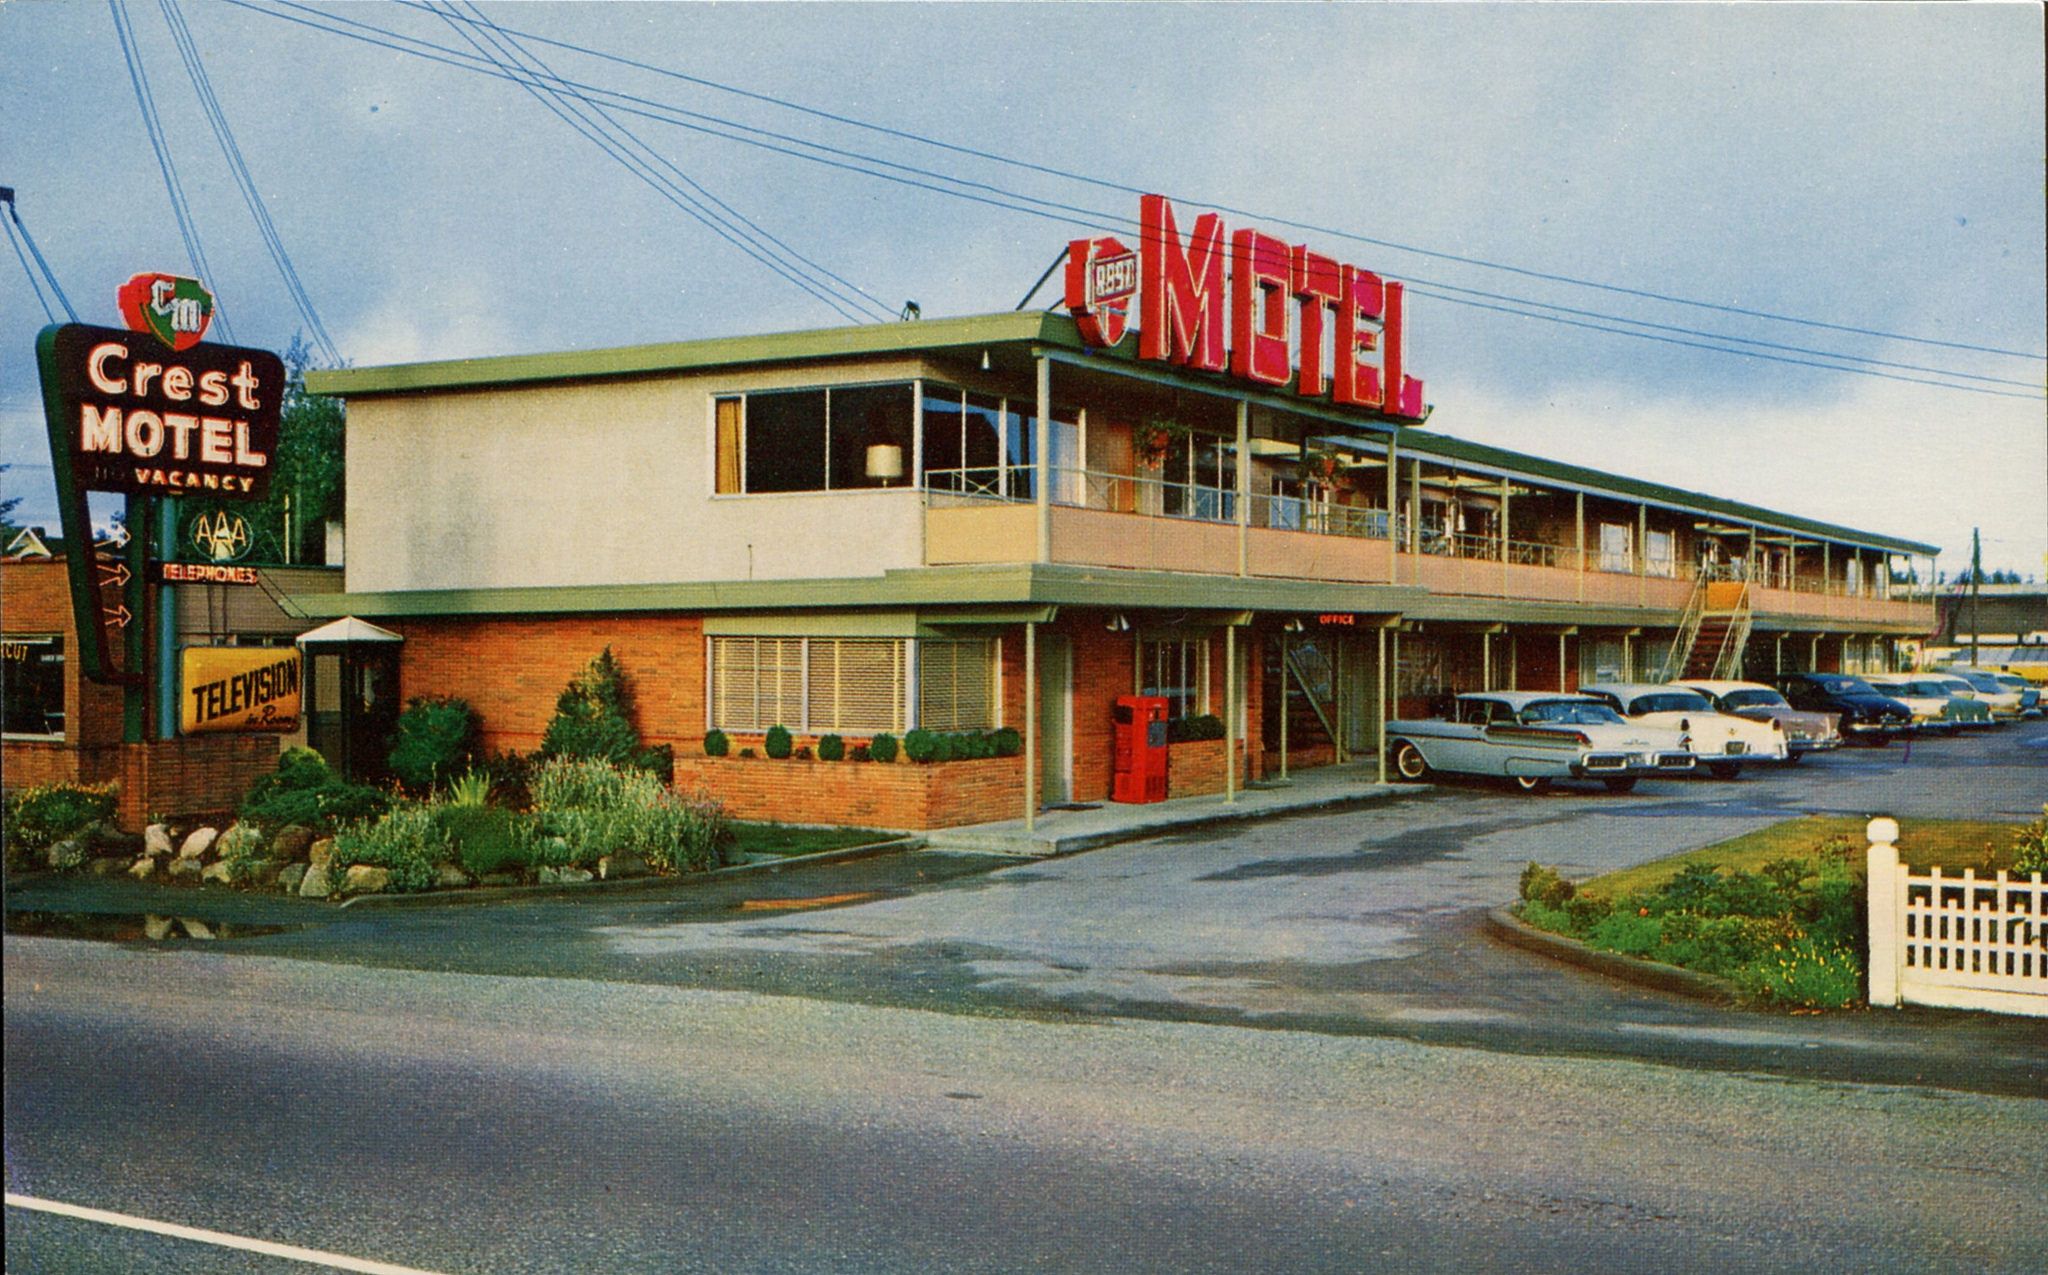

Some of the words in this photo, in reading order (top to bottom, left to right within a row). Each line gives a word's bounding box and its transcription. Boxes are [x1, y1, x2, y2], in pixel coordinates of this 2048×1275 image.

[1139, 194, 1425, 418] MOTEL
[87, 342, 261, 410] Crest
[80, 403, 268, 468] MOTEL
[134, 467, 254, 492] VACANCY
[196, 510, 247, 556] AAA
[163, 563, 257, 584] TELEPHONES
[1319, 614, 1355, 625] OFFICE
[192, 657, 298, 724] TELEVISION
